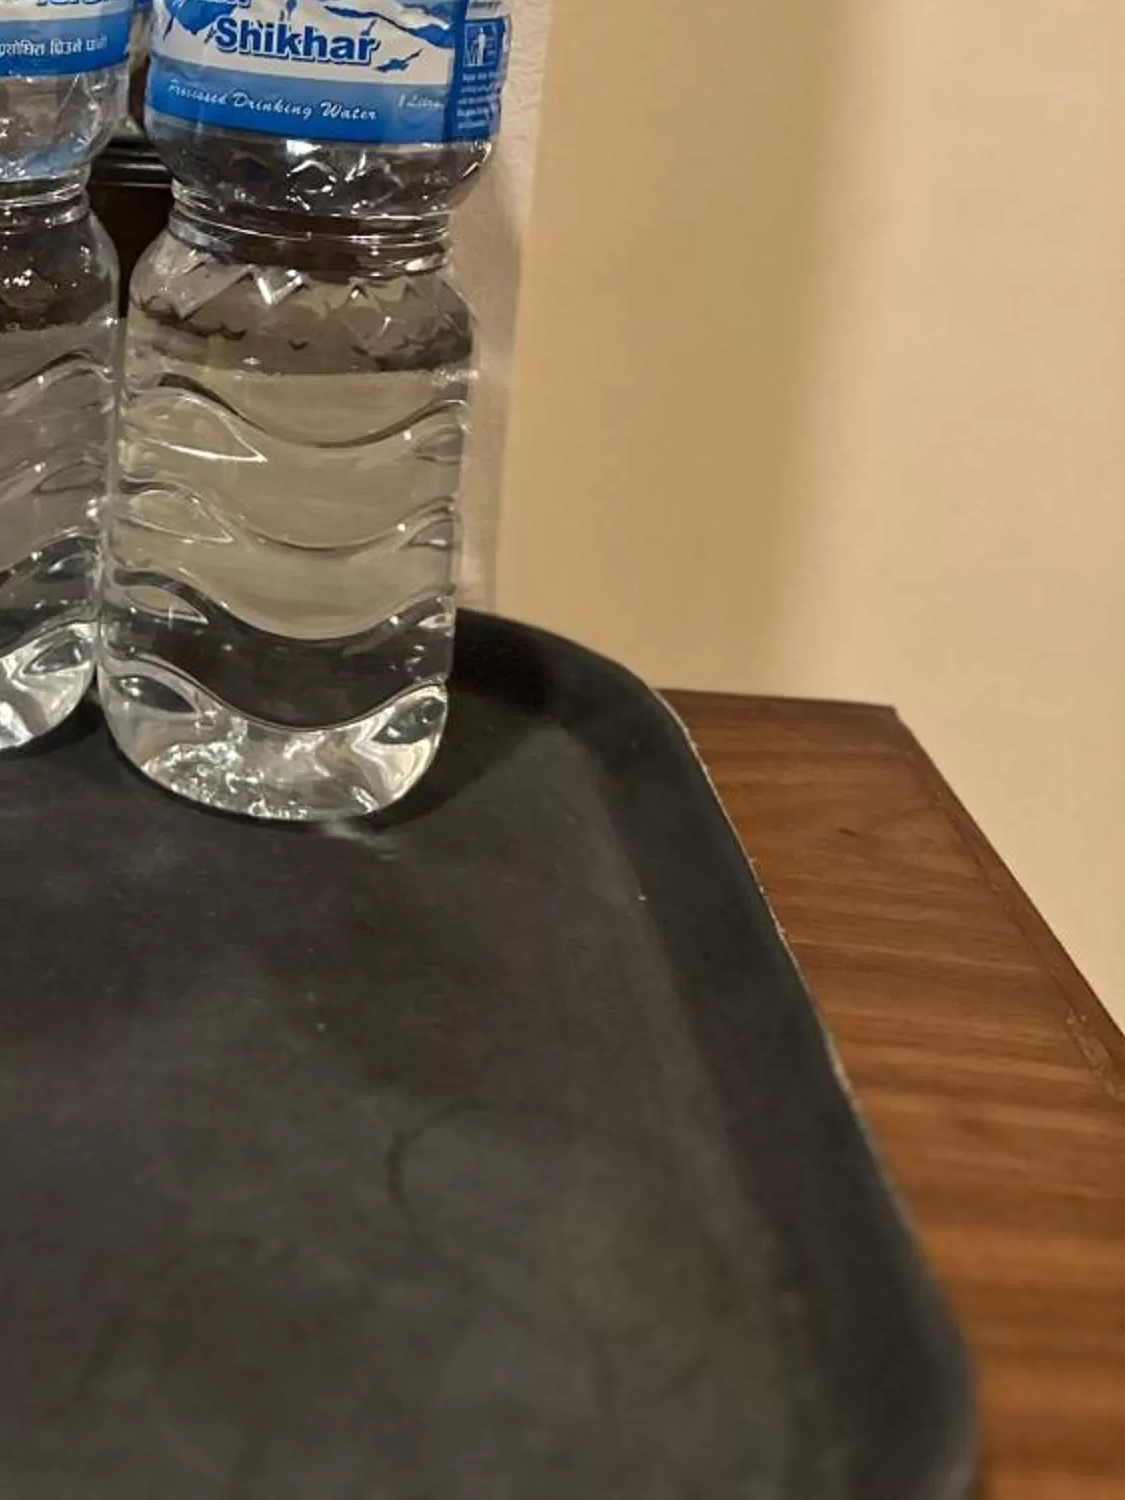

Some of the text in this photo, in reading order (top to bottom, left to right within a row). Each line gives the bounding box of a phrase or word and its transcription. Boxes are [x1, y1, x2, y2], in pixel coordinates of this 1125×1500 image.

[213, 16, 380, 65] Shikhar
[232, 90, 313, 121] Drinking
[320, 100, 377, 120] Water
